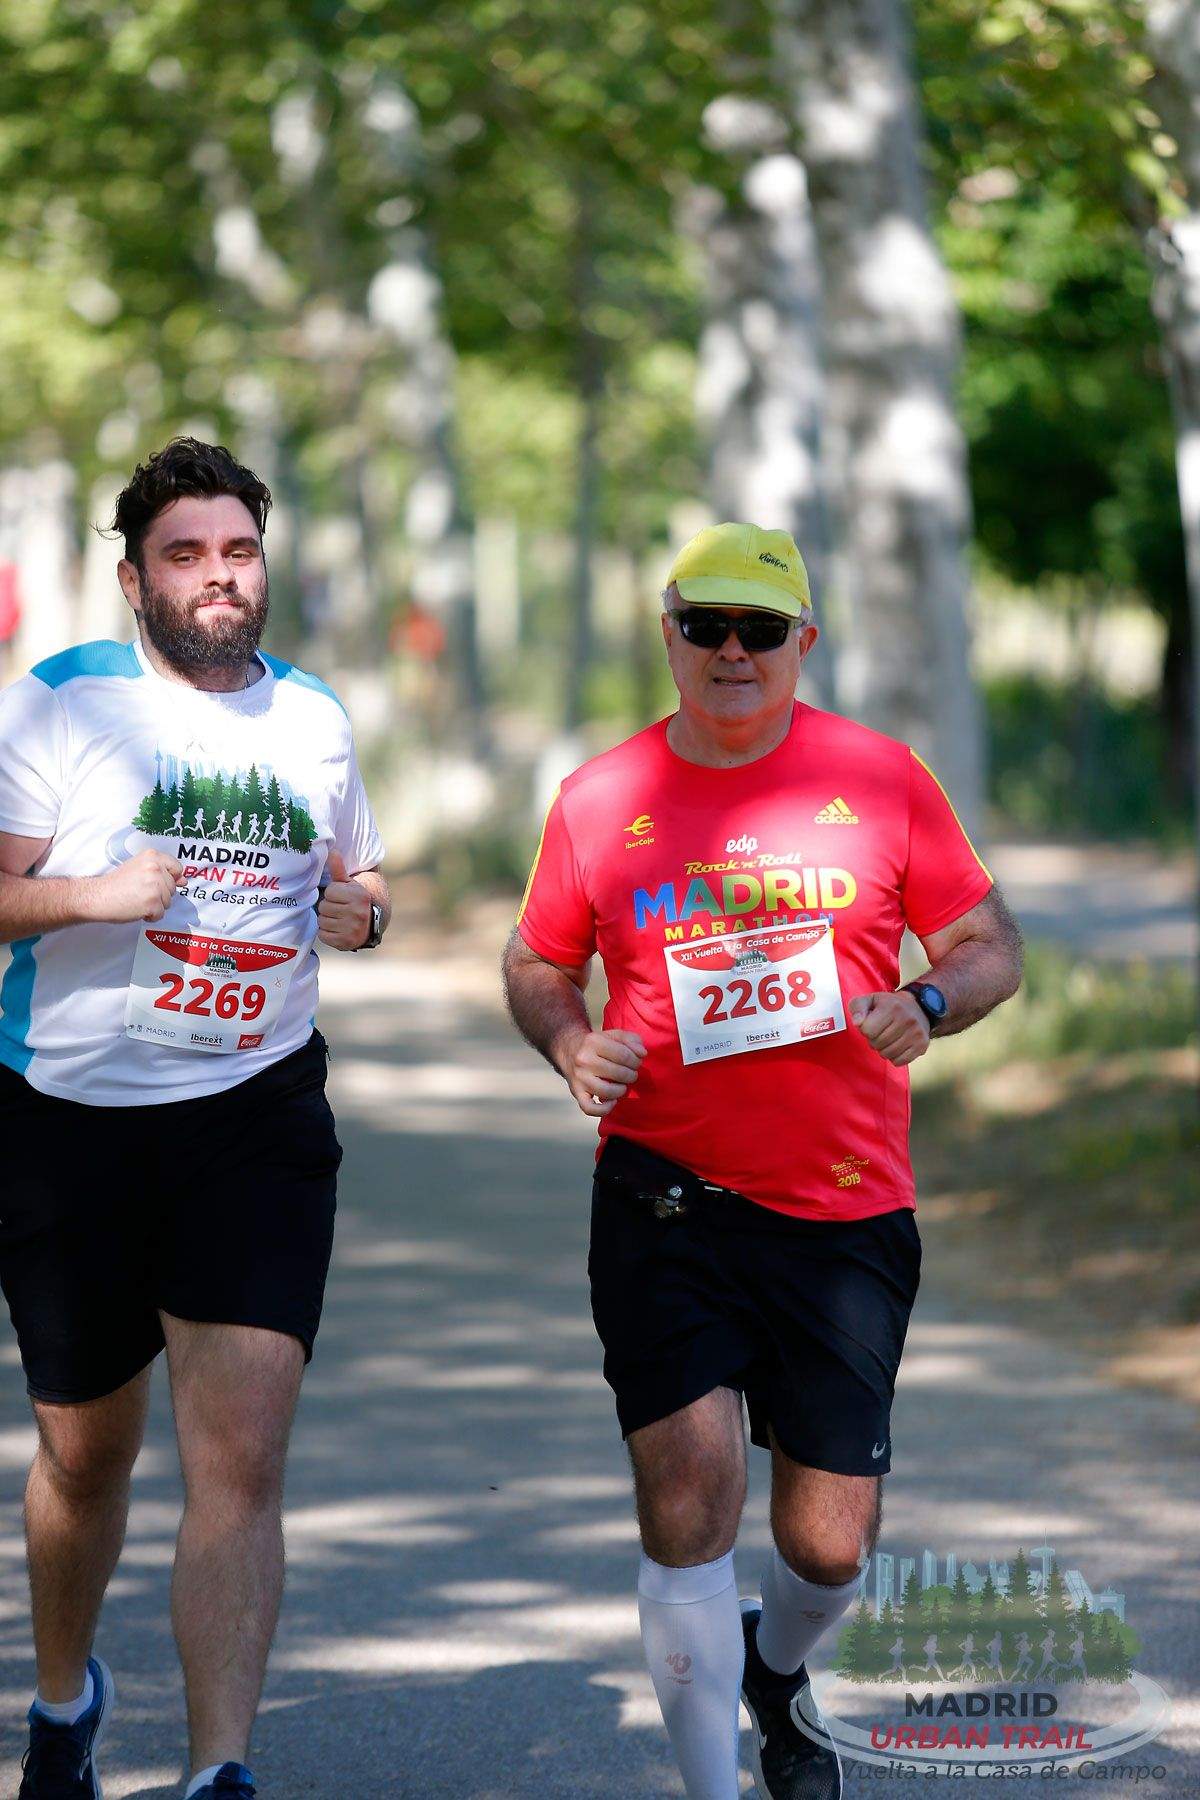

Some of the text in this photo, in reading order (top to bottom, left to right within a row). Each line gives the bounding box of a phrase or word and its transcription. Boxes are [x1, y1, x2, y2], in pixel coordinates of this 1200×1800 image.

[814, 813, 860, 825] adidas
[178, 843, 270, 869] MADRID
[725, 833, 759, 856] edp
[684, 859, 738, 875] Rock
[757, 852, 803, 868] Roll
[182, 866, 281, 891] BAN TRAIL
[193, 886, 207, 900] la
[211, 889, 246, 905] Casa
[249, 894, 268, 906] de
[633, 867, 858, 930] MADRID
[153, 934, 167, 943] XII
[169, 936, 199, 948] Vuelta
[209, 942, 219, 951] la
[222, 944, 244, 954] Casa
[245, 946, 256, 955] de
[257, 947, 289, 959] Campo
[680, 952, 693, 962] XII
[694, 945, 723, 960] Vuelta
[746, 938, 769, 948] Casa
[771, 935, 785, 943] de
[786, 930, 820, 943] Campo
[154, 972, 266, 1022] 2269
[698, 970, 816, 1025] 2268
[145, 1026, 177, 1039] MADRID
[190, 1033, 223, 1045] Iberext
[703, 1040, 732, 1052] MADRID
[746, 1030, 781, 1043] Iberext
[836, 1171, 861, 1188] 2019
